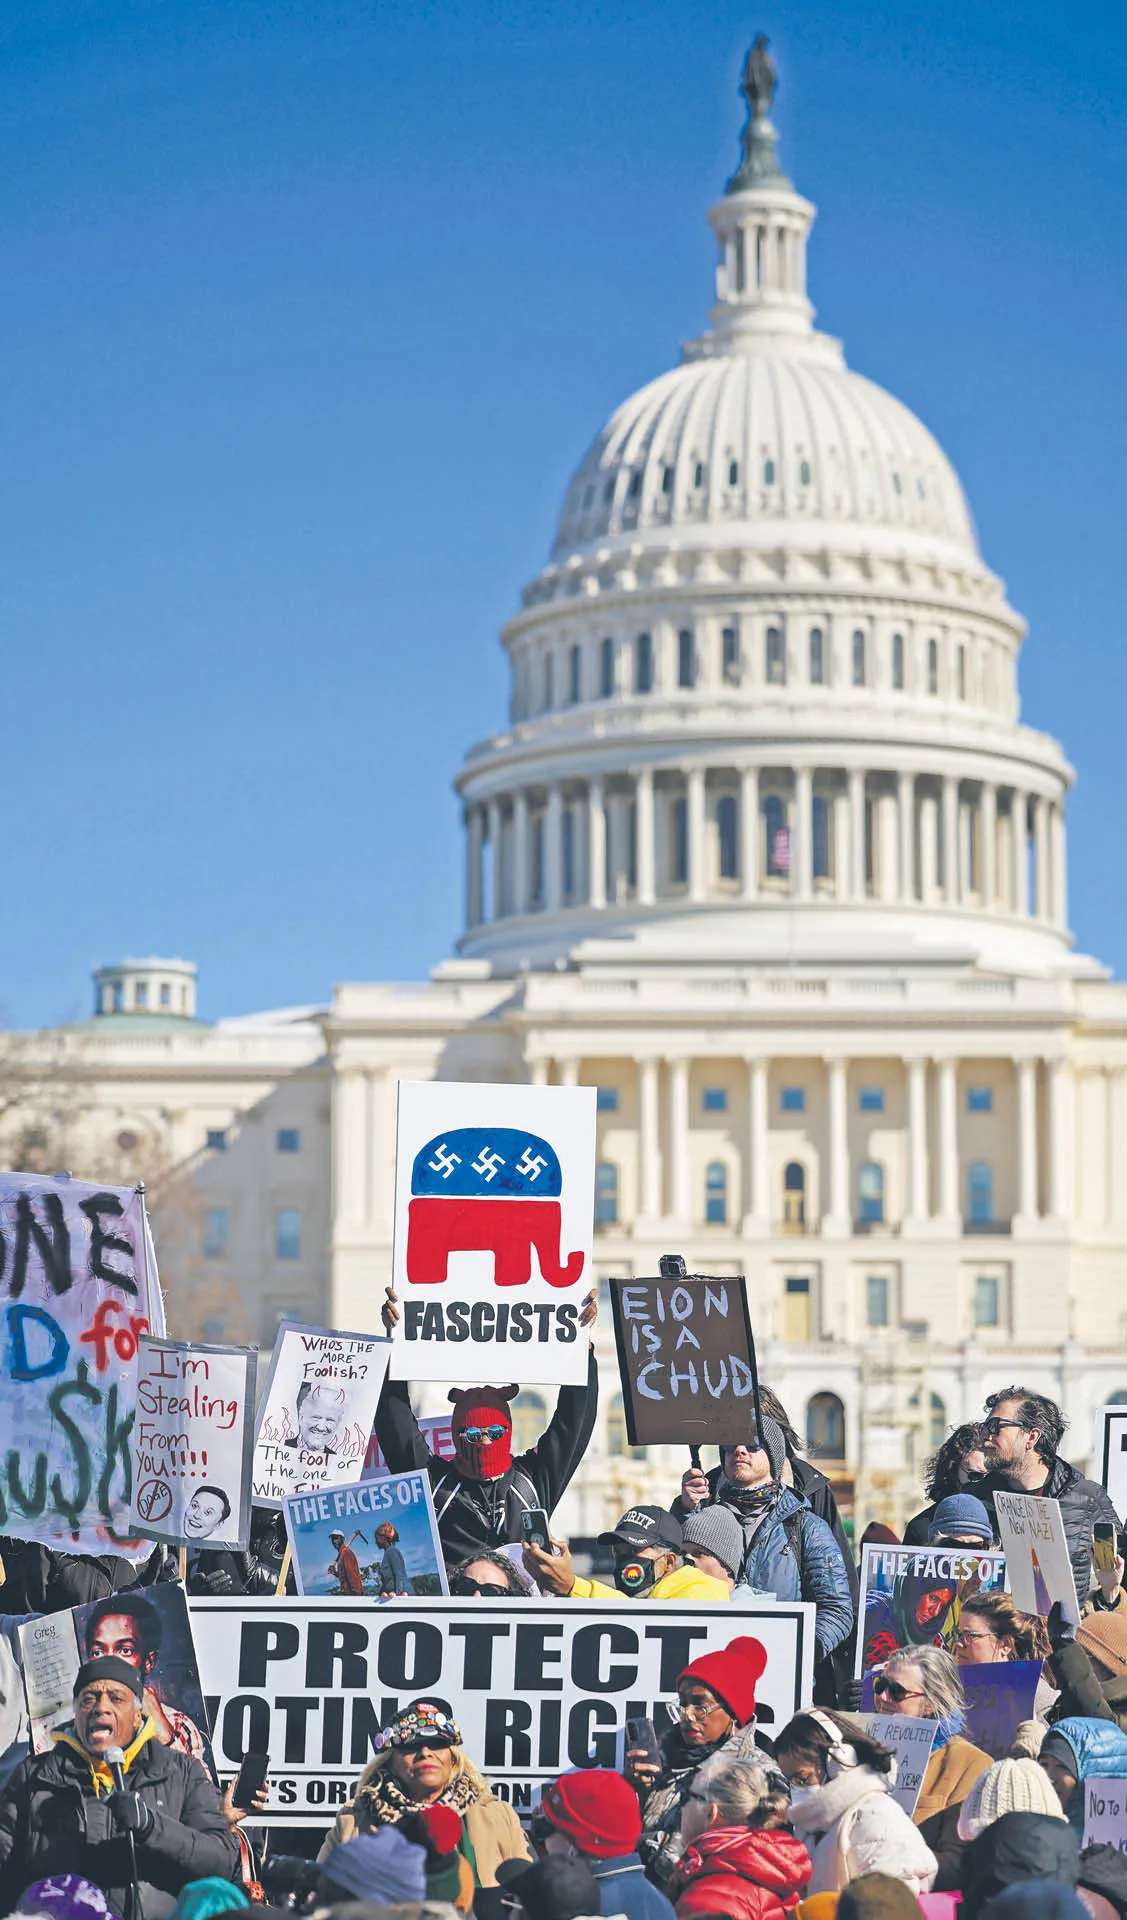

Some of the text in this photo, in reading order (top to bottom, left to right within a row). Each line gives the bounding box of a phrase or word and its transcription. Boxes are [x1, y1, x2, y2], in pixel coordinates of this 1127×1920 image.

[0, 1191, 139, 1297] NE
[404, 1301, 578, 1343] FASCISTS
[346, 1341, 375, 1353] THE
[631, 1323, 701, 1354] IS A
[148, 1348, 209, 1380] I'm
[303, 1362, 368, 1379] Foolish?
[320, 1352, 356, 1363] MORE
[636, 1354, 753, 1400] CHUD
[137, 1380, 238, 1429] Stealing
[139, 1423, 190, 1451] From
[258, 1445, 291, 1461] The
[337, 1459, 358, 1470] or
[265, 1463, 332, 1481] the one
[289, 1478, 423, 1525] THE FACES OF
[869, 1551, 1005, 1583] THE FACES OF
[34, 1624, 56, 1640] Greg
[238, 1620, 708, 1694] PROTECT
